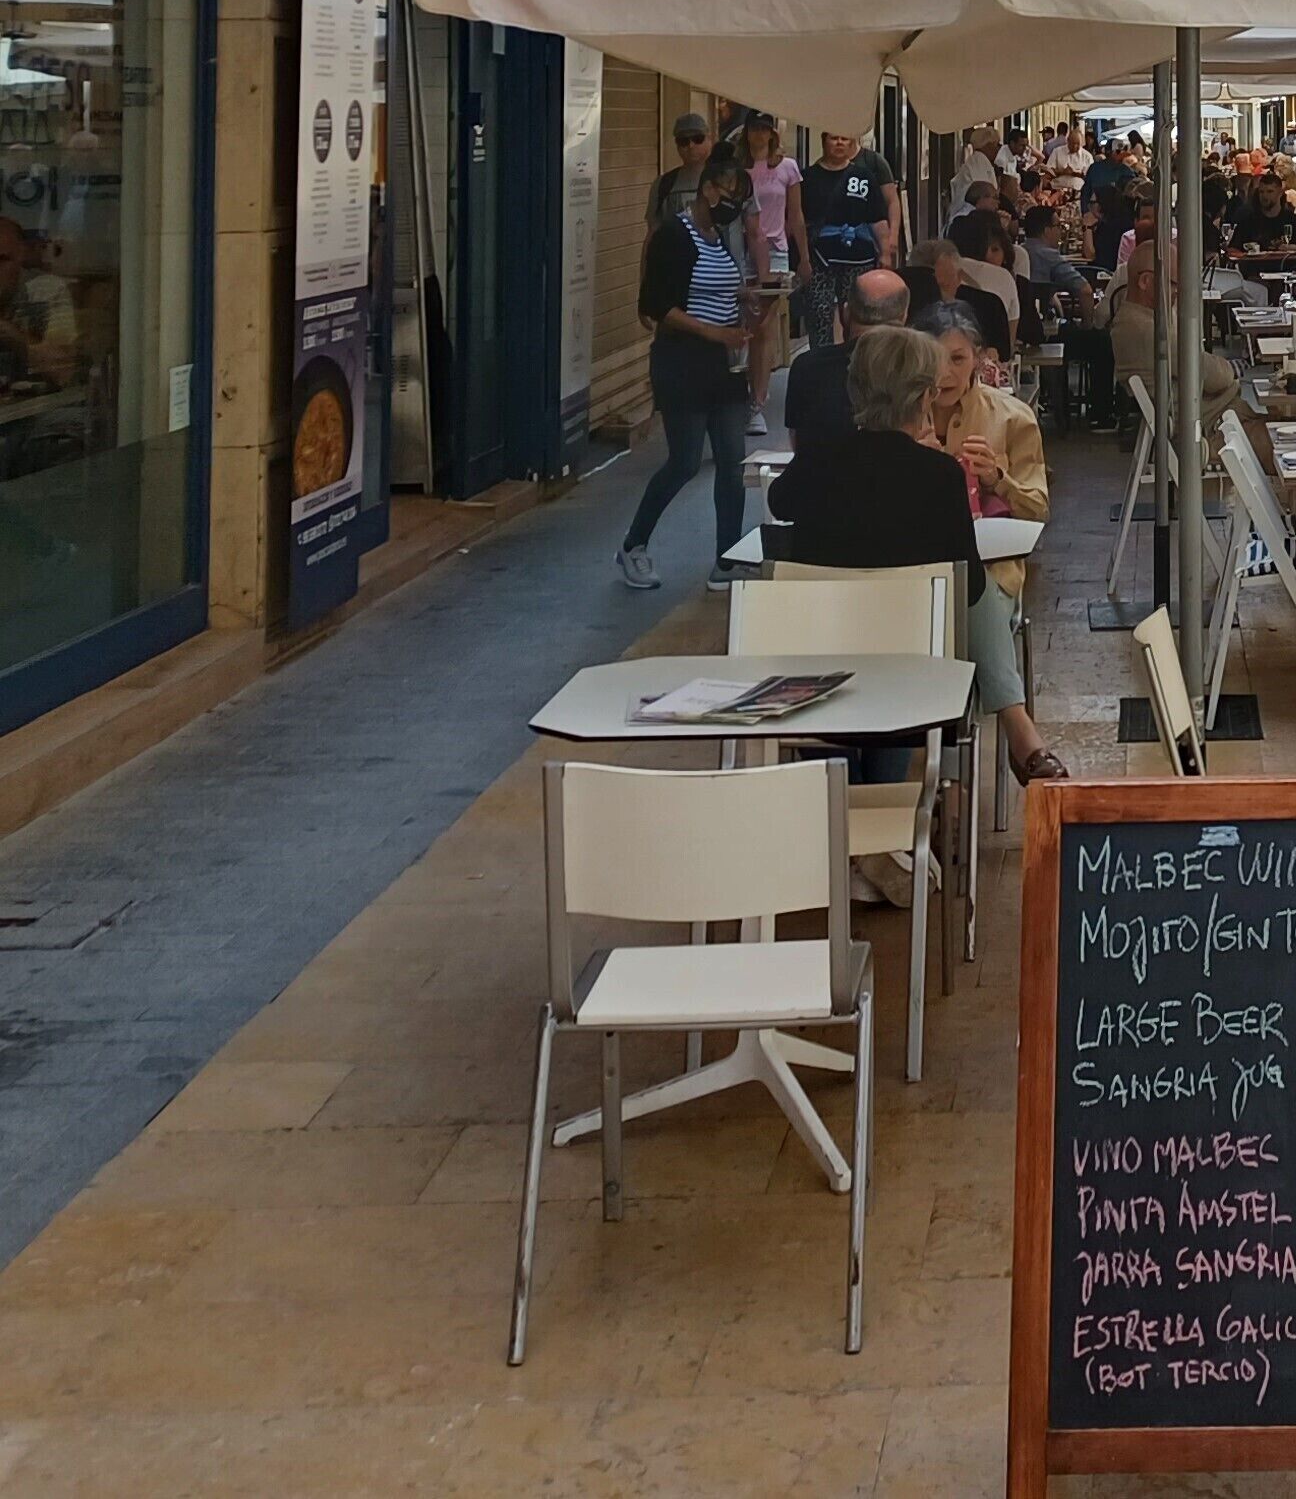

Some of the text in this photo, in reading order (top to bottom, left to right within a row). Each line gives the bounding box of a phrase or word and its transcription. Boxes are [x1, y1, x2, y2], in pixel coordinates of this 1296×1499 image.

[847, 176, 869, 198] 86
[1078, 835, 1225, 894] MALBEC
[1075, 998, 1182, 1050] LARGE
[1191, 991, 1289, 1047] BEER
[1072, 1062, 1219, 1108] SANGRIA
[1073, 1135, 1142, 1177] VINO
[1154, 1131, 1279, 1177] MALBEC
[1076, 1184, 1165, 1239] PINTA
[1073, 1248, 1162, 1306] JARRA
[1073, 1309, 1205, 1358] ESTRELLA
